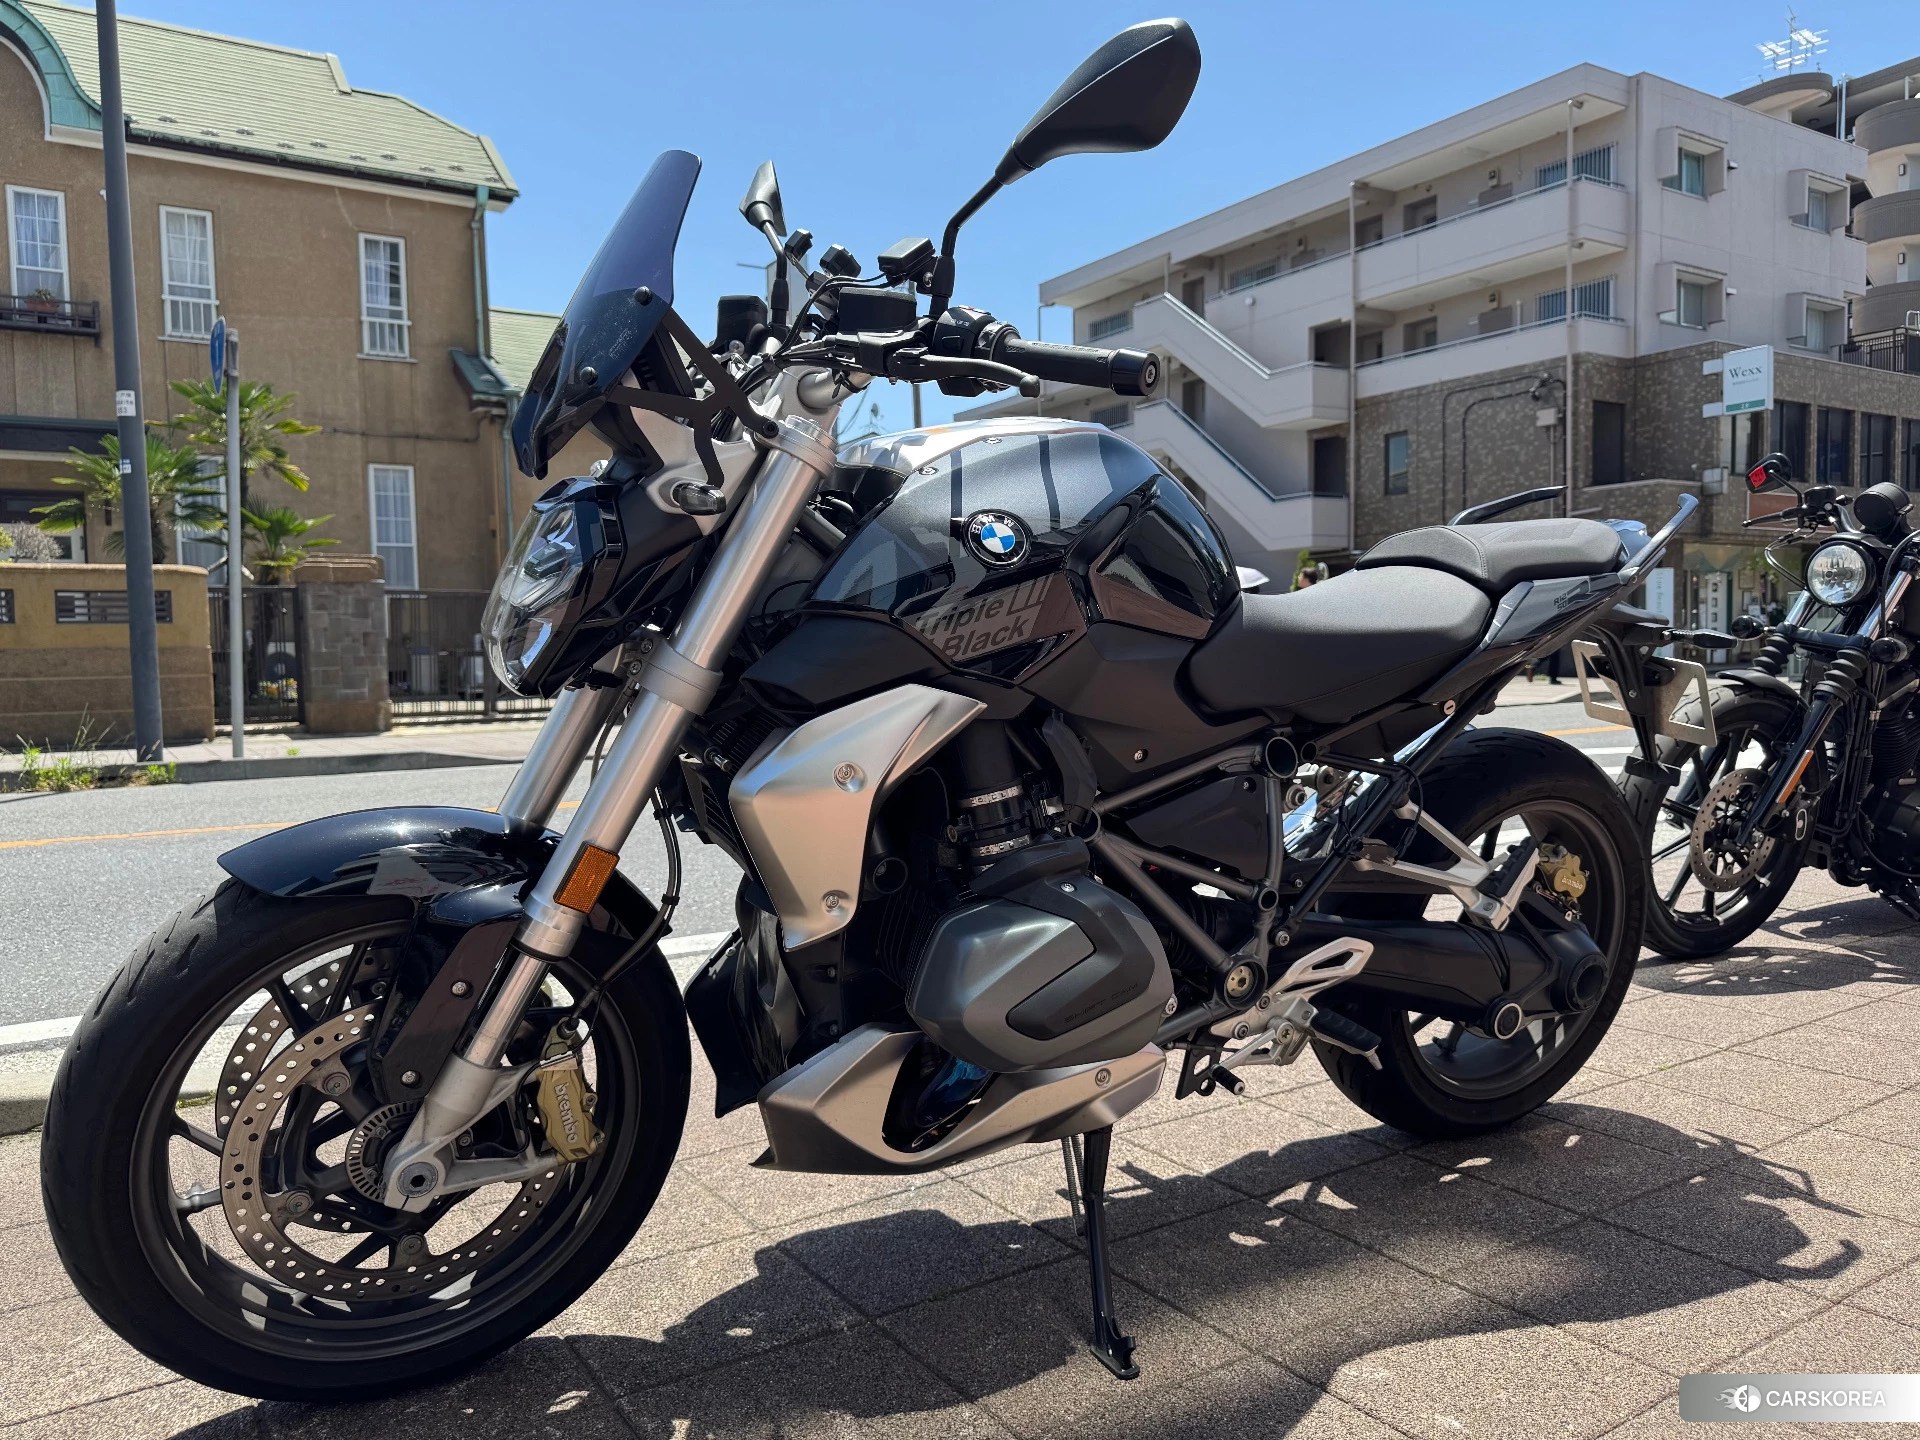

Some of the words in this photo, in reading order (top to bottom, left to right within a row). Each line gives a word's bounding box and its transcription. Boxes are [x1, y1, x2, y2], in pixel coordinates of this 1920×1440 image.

[1729, 366, 1762, 378] Wexx
[971, 515, 1014, 534] BMW
[915, 597, 1003, 636] Triple
[943, 616, 1029, 658] Black
[554, 1082, 579, 1144] brembo
